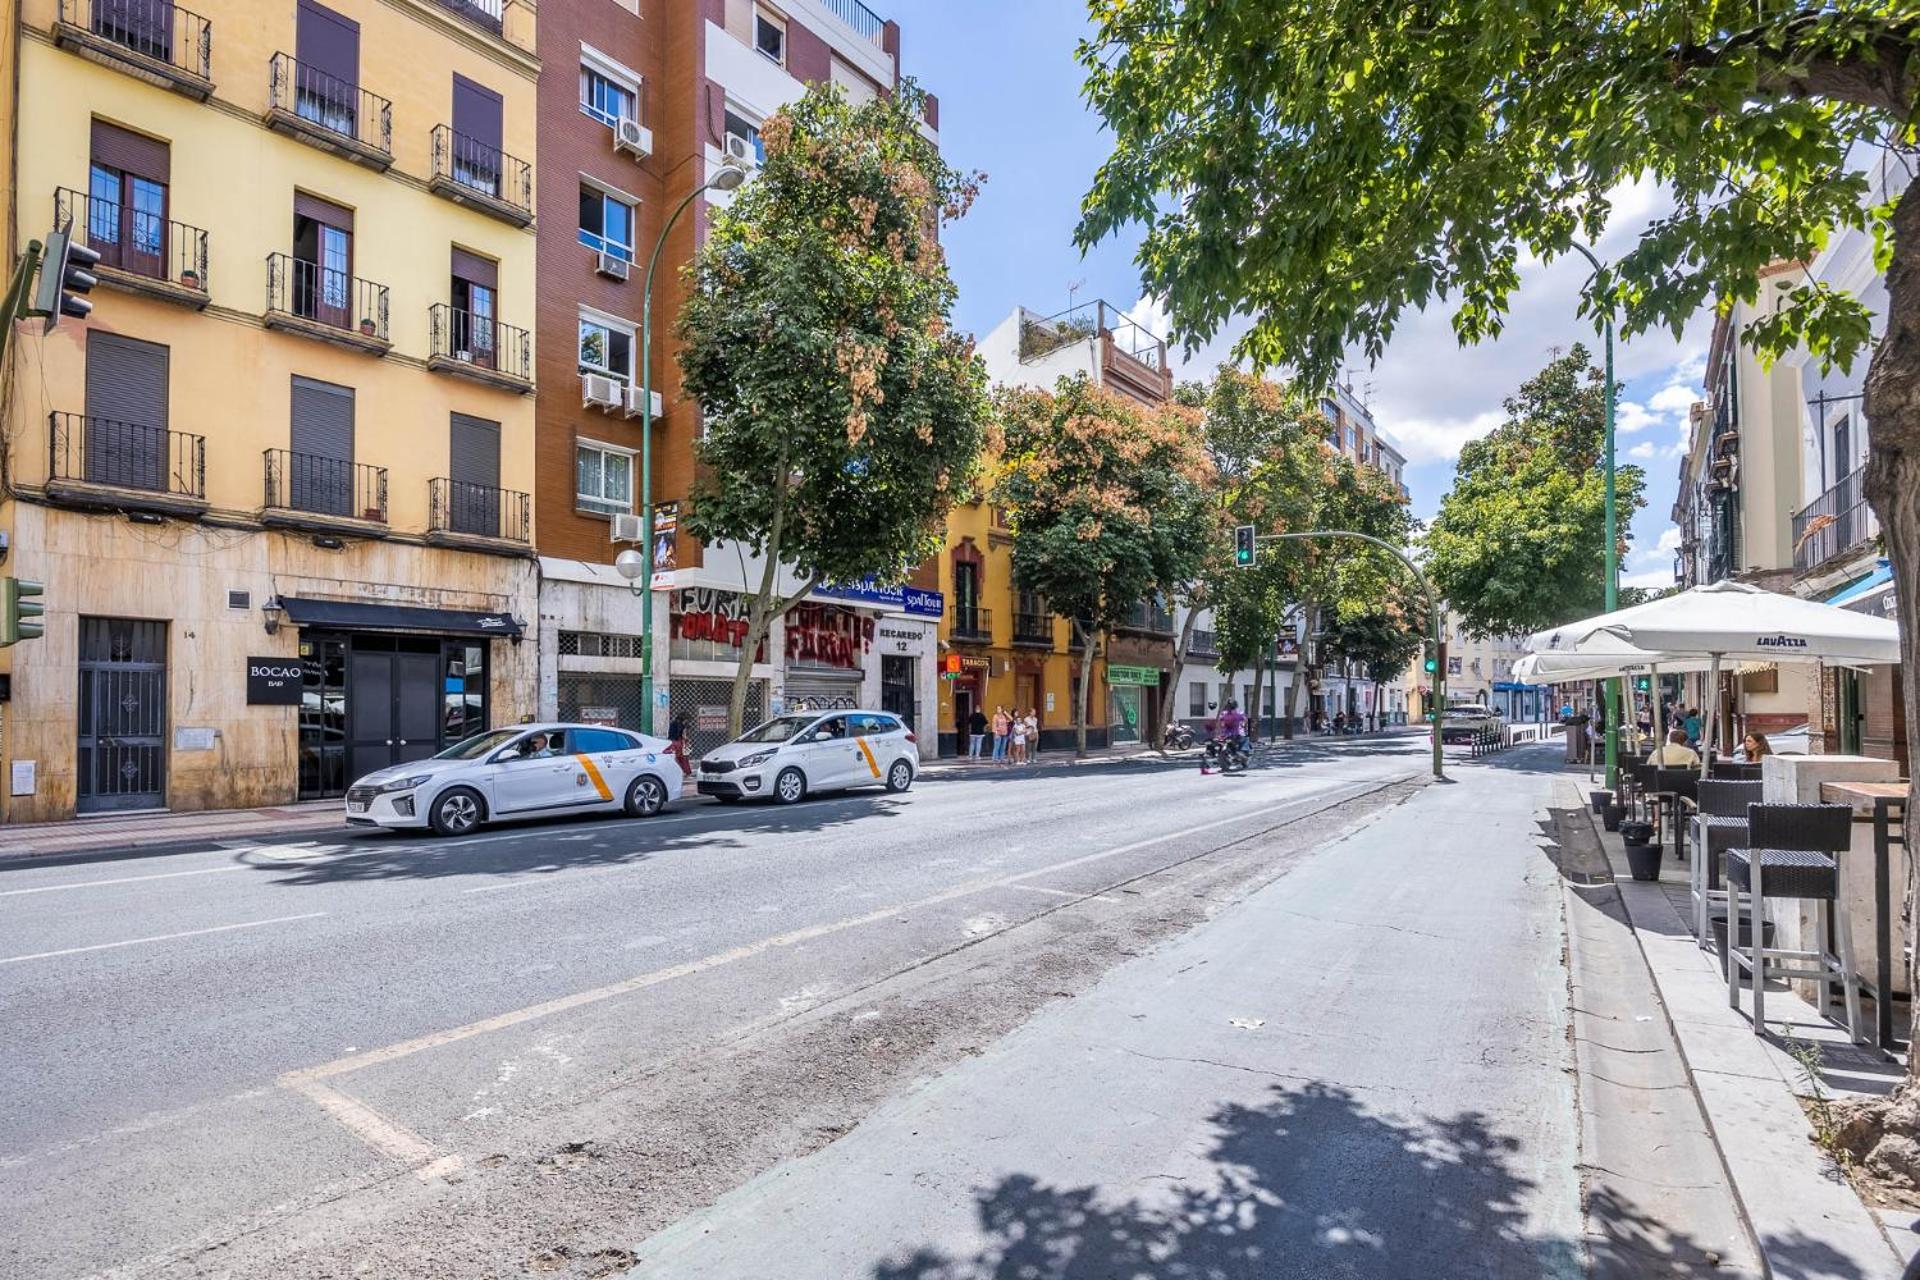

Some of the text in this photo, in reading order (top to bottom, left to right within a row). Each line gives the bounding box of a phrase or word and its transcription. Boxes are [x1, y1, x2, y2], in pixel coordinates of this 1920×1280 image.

[680, 587, 751, 621] FURIA
[880, 628, 923, 640] RECAREDO
[896, 641, 908, 651] 12
[1756, 635, 1808, 648] LAVAZZA
[251, 666, 301, 678] BOCAO
